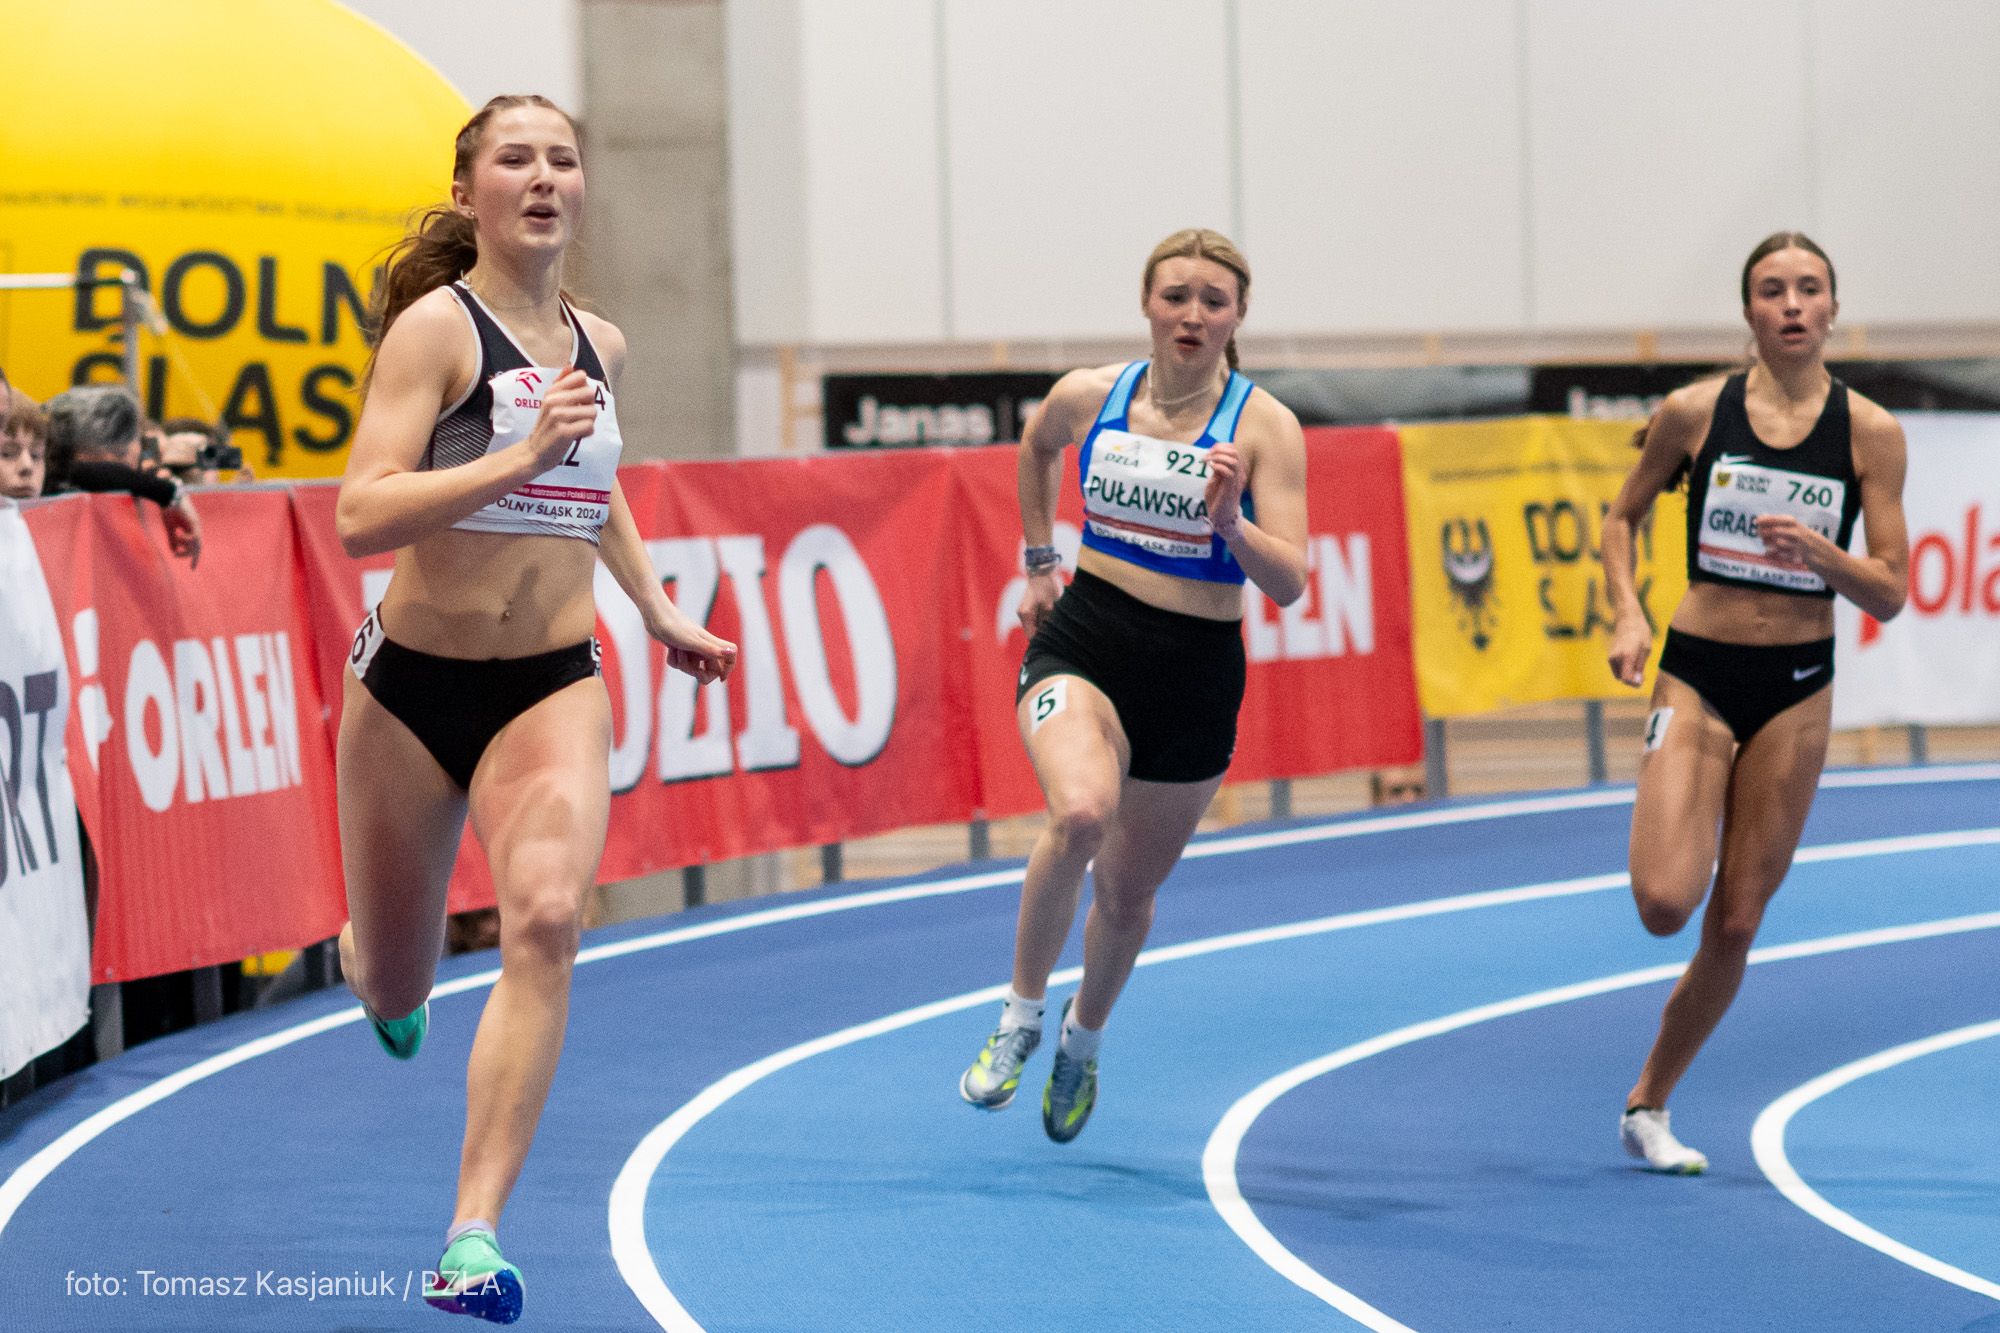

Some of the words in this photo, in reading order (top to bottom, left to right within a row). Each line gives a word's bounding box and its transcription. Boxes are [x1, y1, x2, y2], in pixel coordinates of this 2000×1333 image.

[514, 397, 542, 410] ORLE
[844, 394, 995, 445] Janas
[1165, 449, 1208, 479] 921
[496, 497, 534, 513] OLNY
[535, 501, 574, 520] ŚLĄSK
[576, 507, 602, 520] 2024
[1088, 475, 1209, 521] PUŁAWSKA
[1787, 480, 1833, 508] 760
[1168, 543, 1199, 555] 2024
[352, 616, 374, 666] 6
[124, 631, 303, 814] ORLEN
[1036, 686, 1057, 723] 5
[1646, 712, 1660, 748] 4
